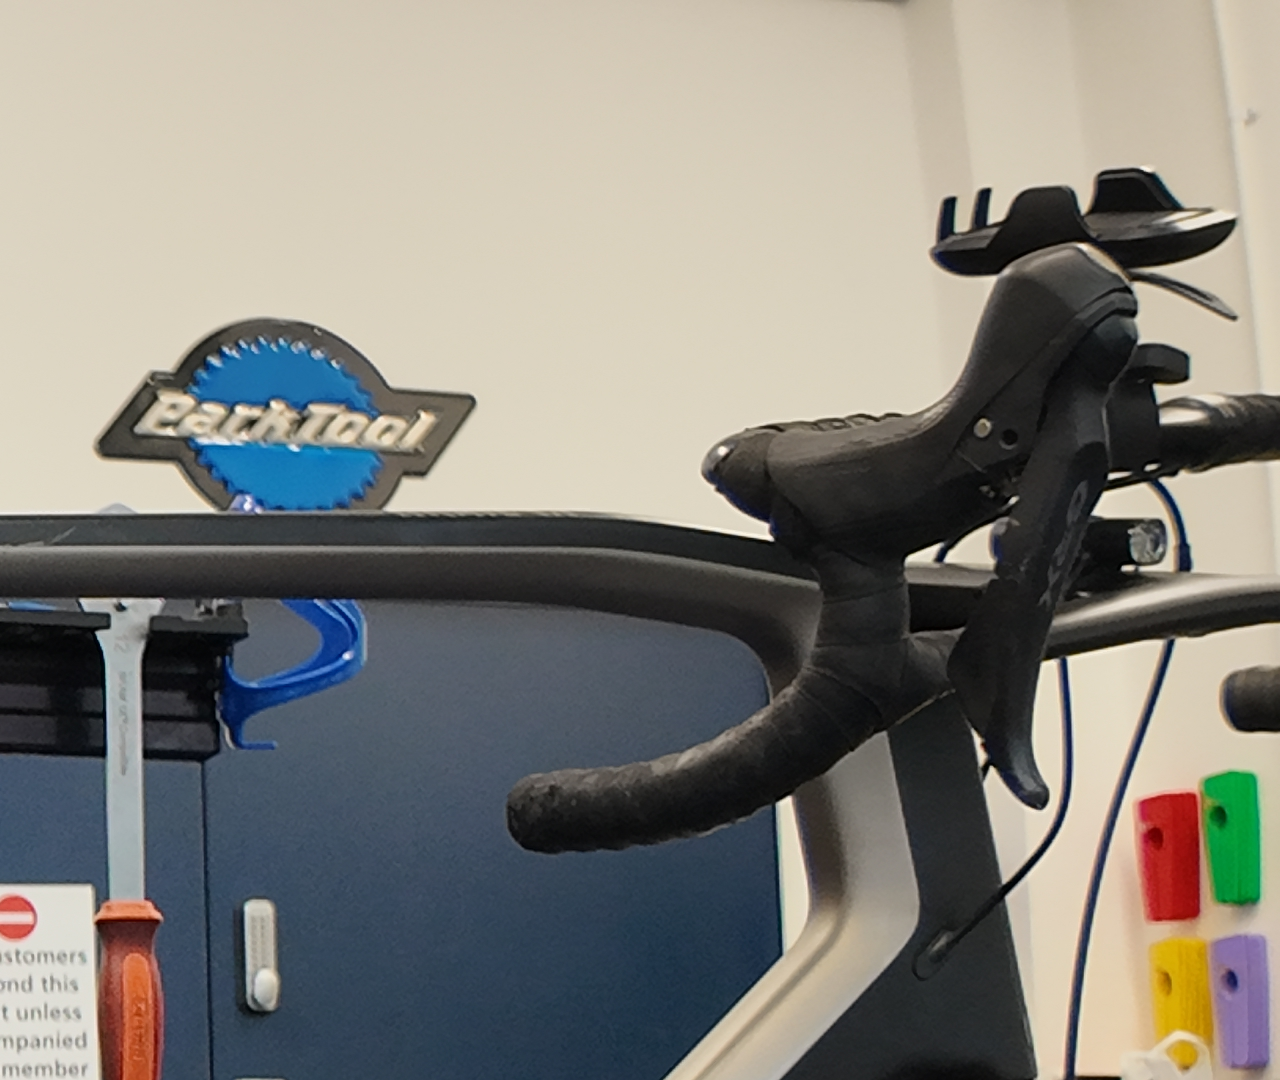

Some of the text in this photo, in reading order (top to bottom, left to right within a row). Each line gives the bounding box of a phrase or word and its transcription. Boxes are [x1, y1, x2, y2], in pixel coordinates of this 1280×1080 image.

[41, 974, 79, 993] this
[16, 1002, 82, 1021] unless
[1, 1060, 88, 1078] member
